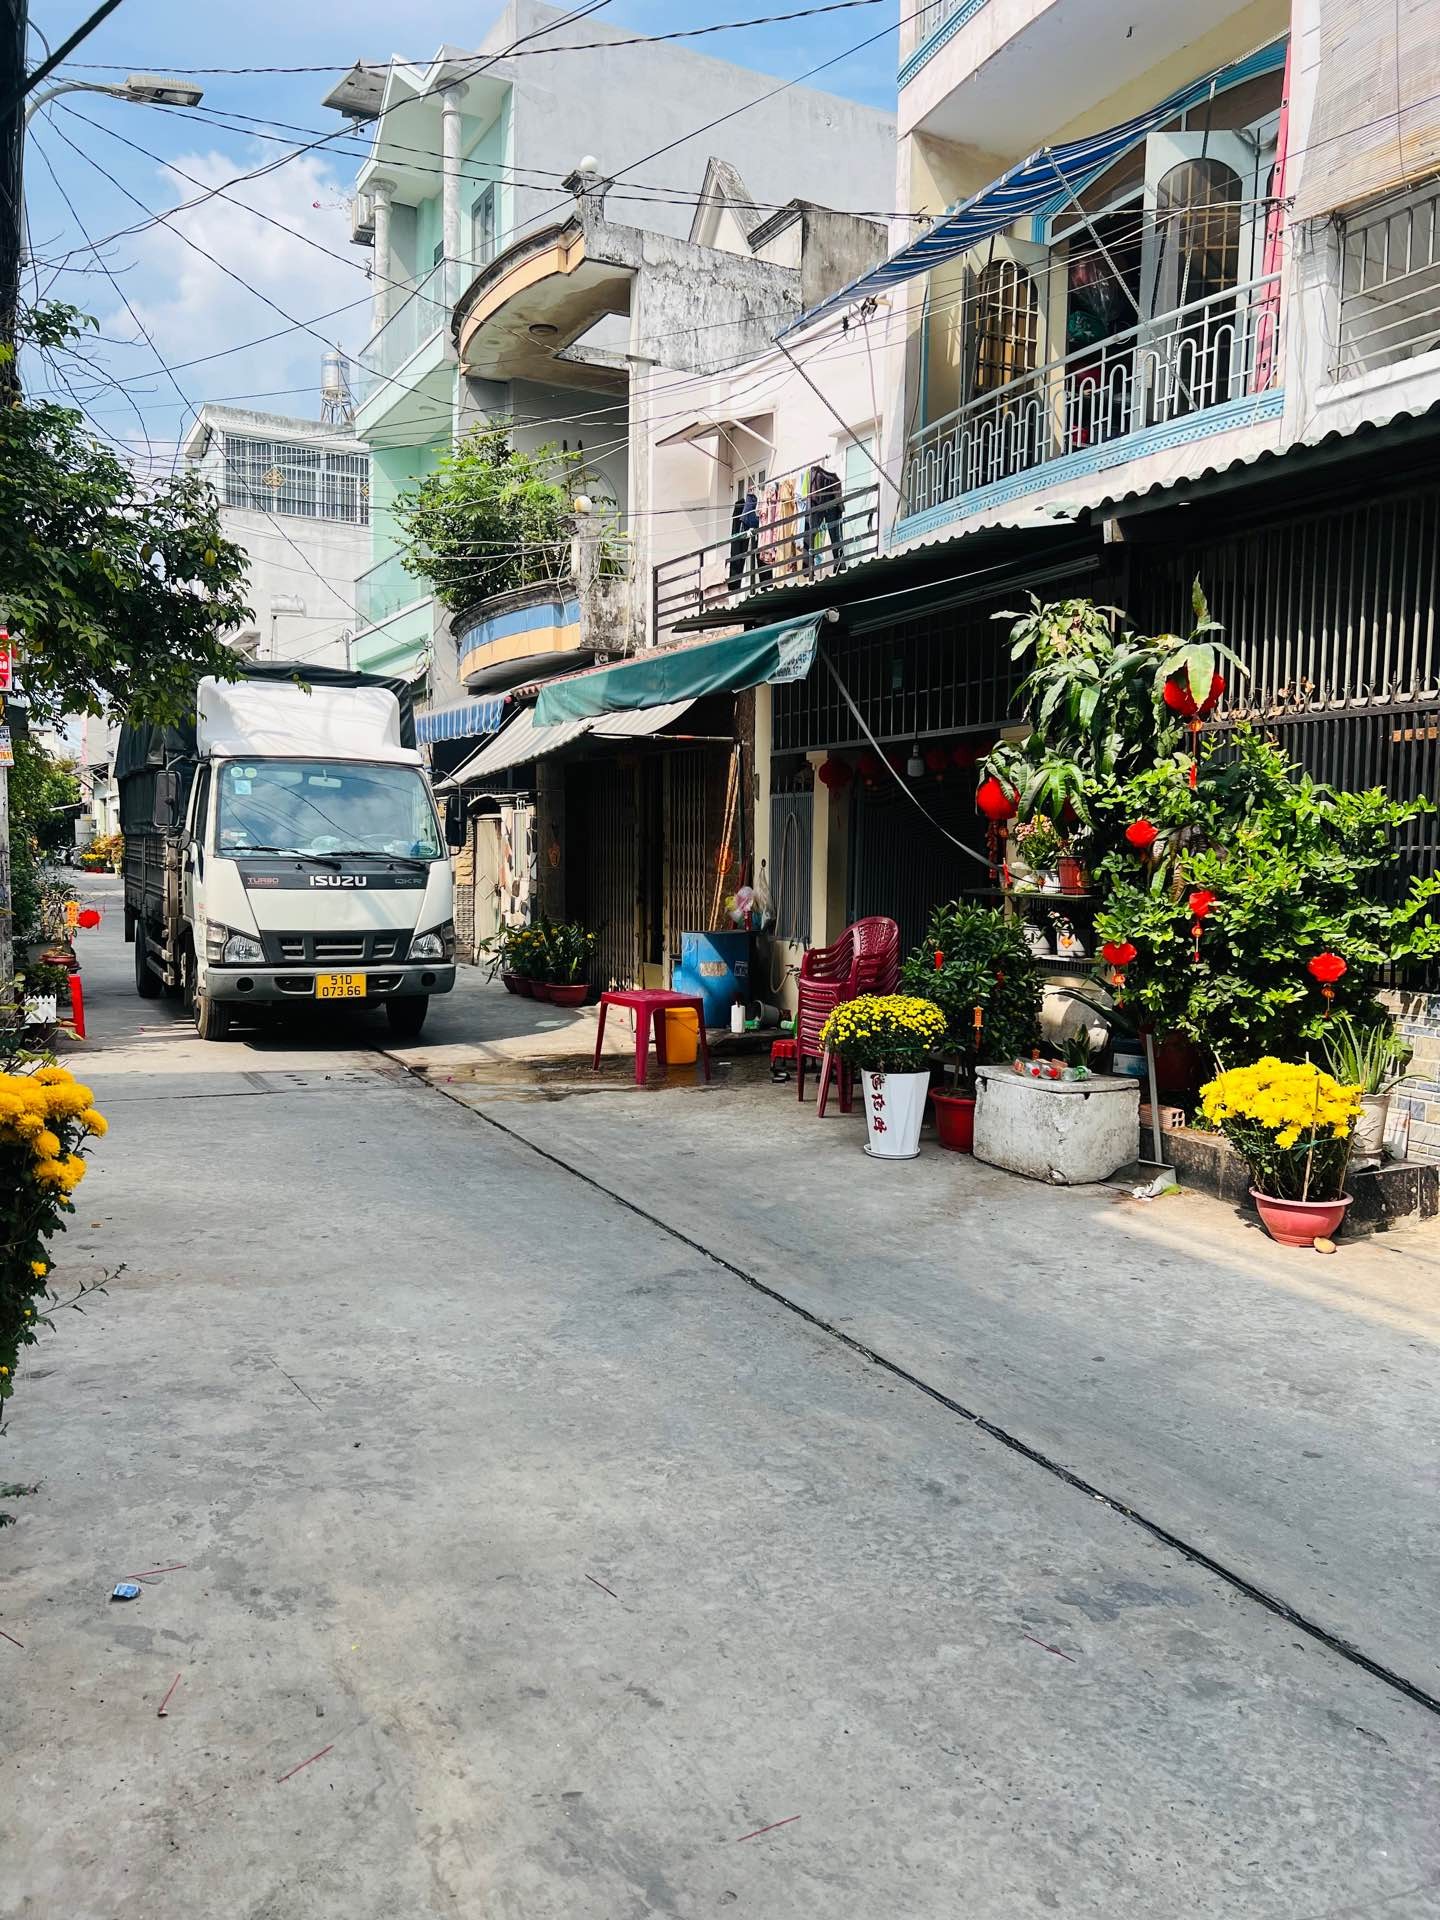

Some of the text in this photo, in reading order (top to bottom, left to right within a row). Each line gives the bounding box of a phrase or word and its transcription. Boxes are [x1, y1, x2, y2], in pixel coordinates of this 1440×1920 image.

[247, 877, 279, 885] TURBO
[309, 875, 367, 887] ISUZU
[331, 974, 352, 985] 51D
[322, 986, 361, 997] 073.66
